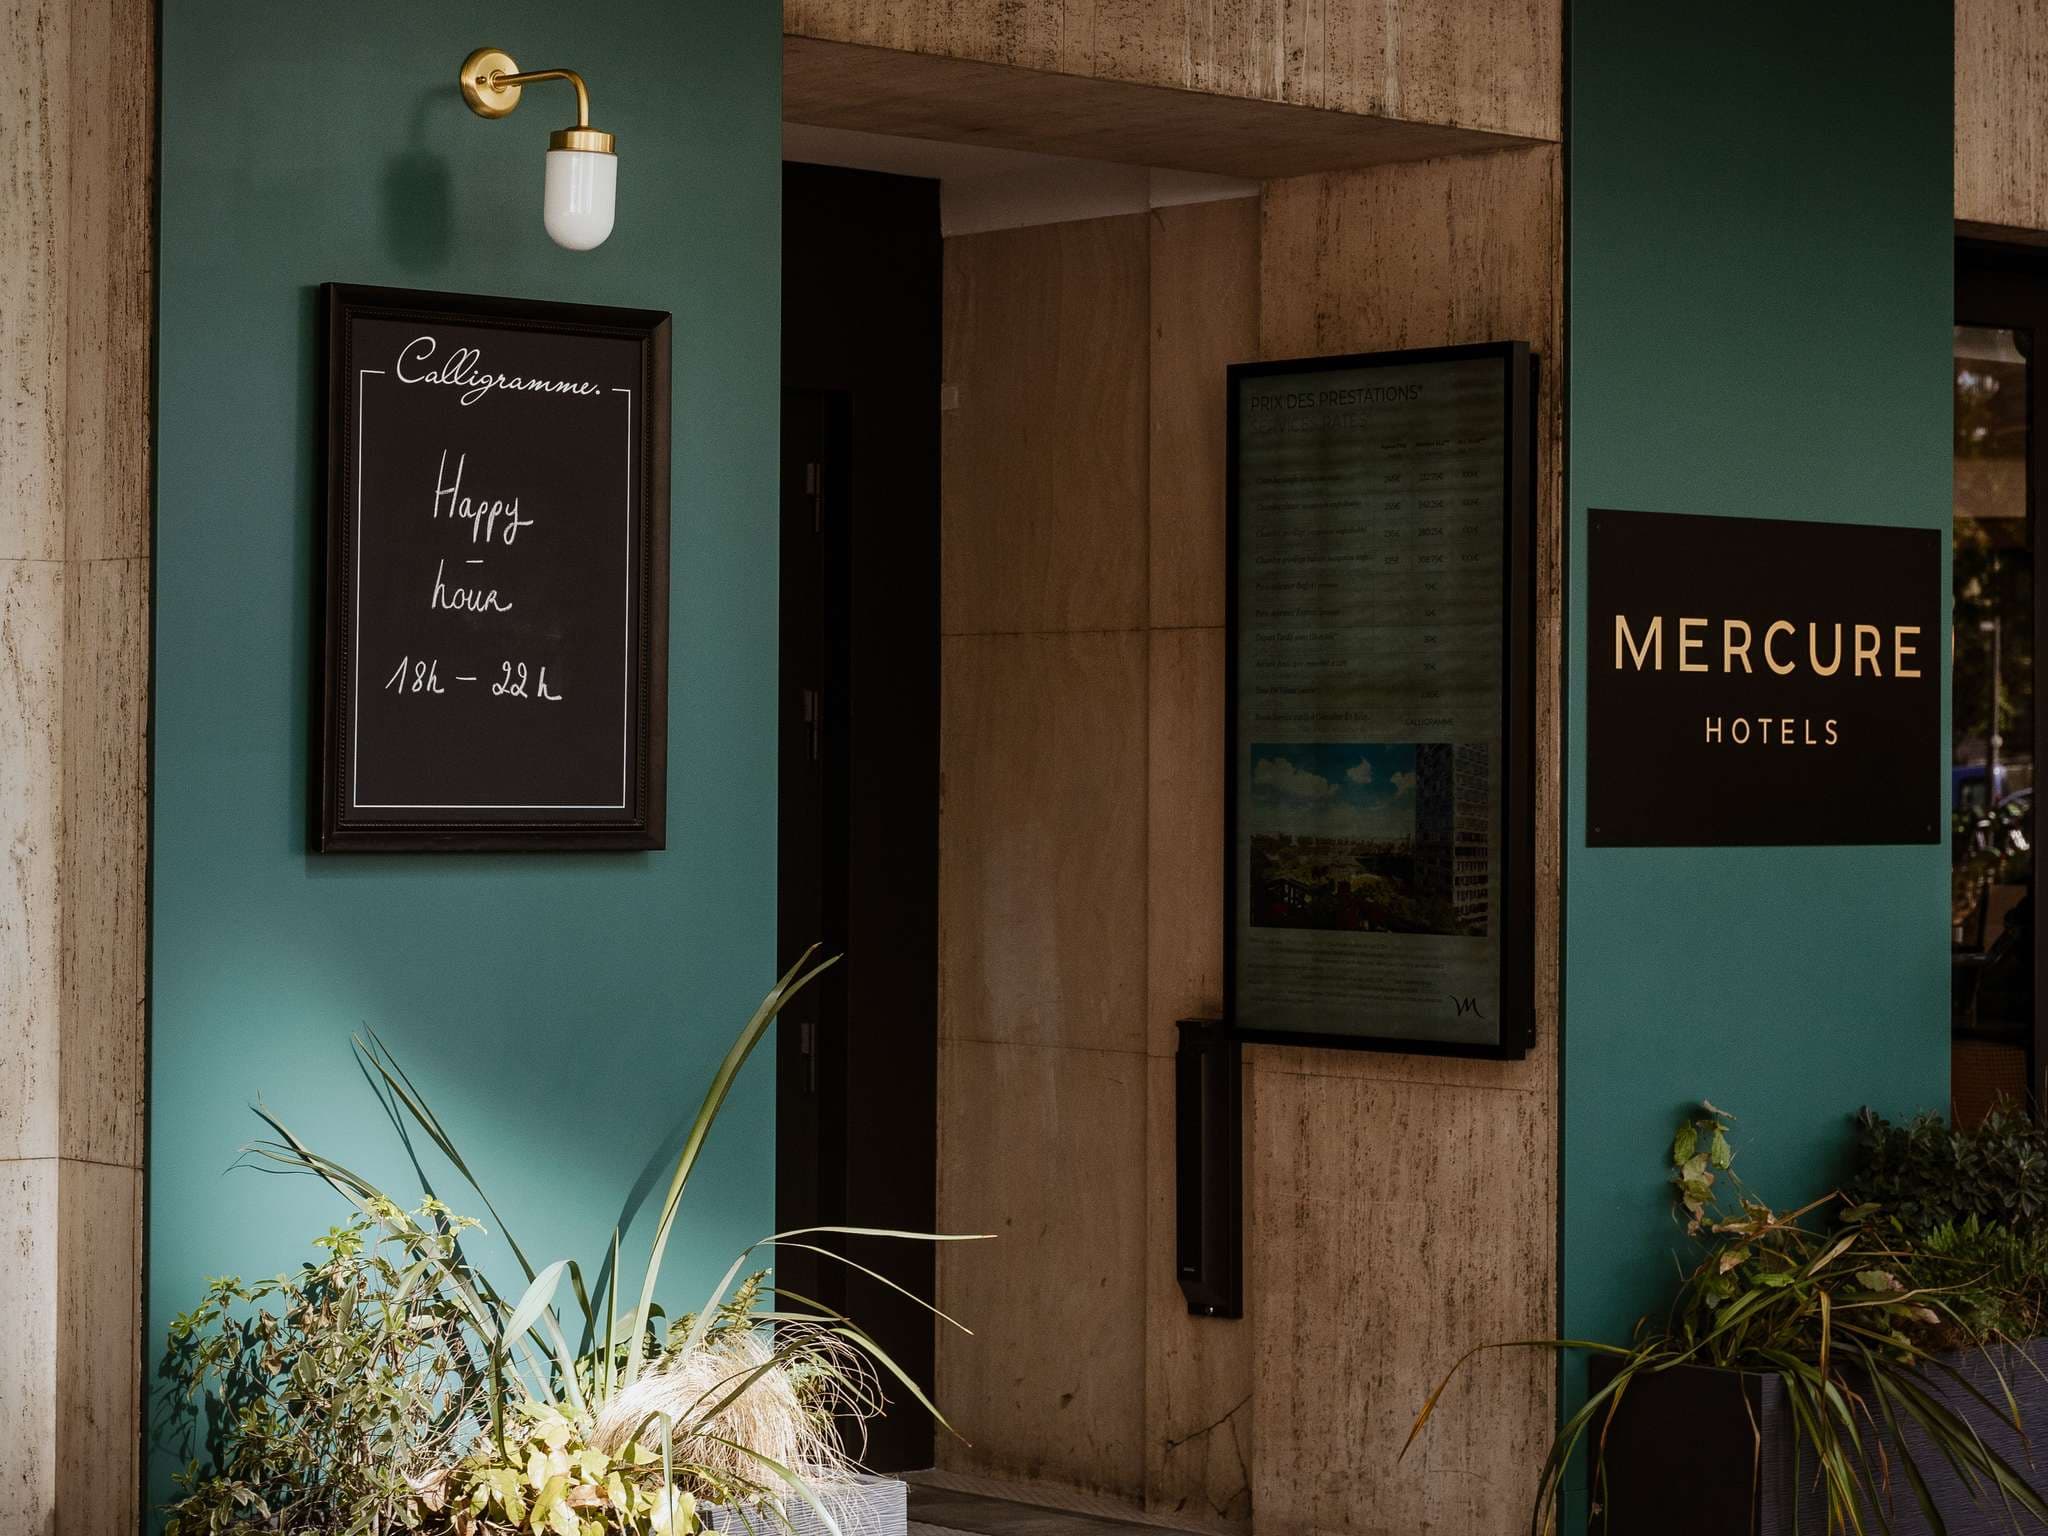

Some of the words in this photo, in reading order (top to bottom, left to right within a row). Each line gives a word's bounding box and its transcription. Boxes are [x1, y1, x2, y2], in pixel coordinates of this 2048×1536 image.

[1250, 395, 1283, 411] PRIX
[1286, 392, 1315, 409] DES
[434, 449, 533, 545] Happy
[432, 559, 512, 612] hour
[1616, 615, 1920, 677] MERCURE
[385, 656, 444, 694] 18h
[1707, 717, 1837, 745] HOTELS
